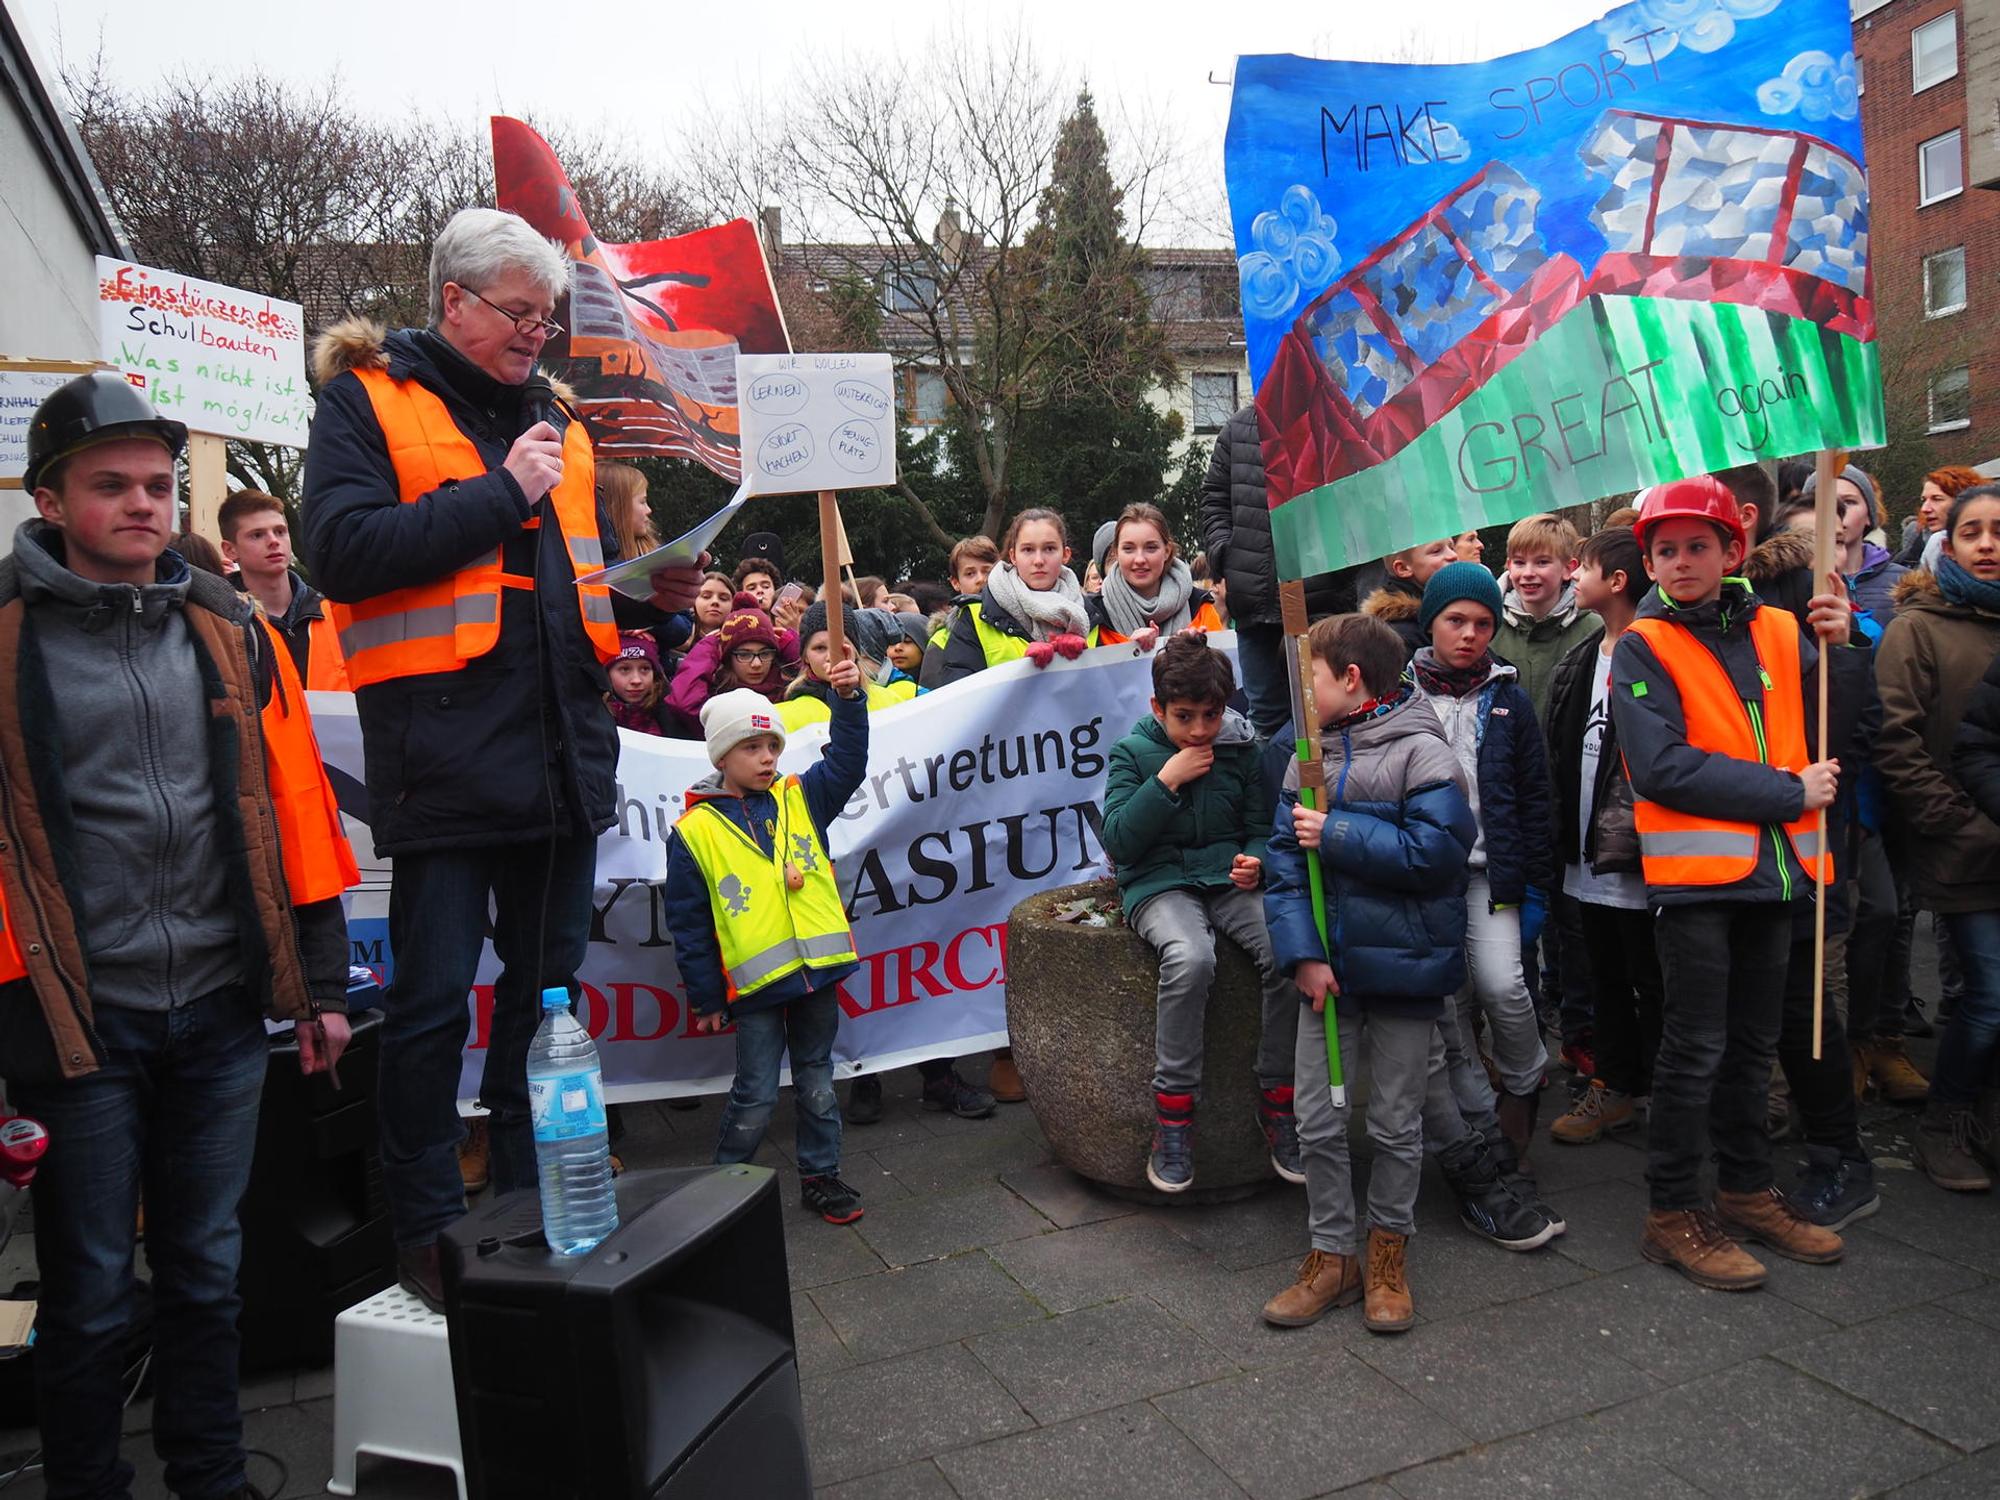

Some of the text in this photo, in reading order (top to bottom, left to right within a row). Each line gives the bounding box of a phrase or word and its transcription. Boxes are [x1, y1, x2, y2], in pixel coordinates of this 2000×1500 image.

[1320, 26, 1667, 178] MAKE SPORT
[116, 266, 285, 330] Einstürzende
[126, 306, 278, 361] Schulbauten
[778, 358, 857, 371] WIR WOLLEN
[151, 377, 187, 407] ist
[196, 363, 255, 388] nicht
[265, 375, 296, 396] ist
[752, 383, 802, 401] LERNEN
[767, 427, 802, 449] SPORT
[842, 425, 876, 448] GENUG
[1456, 359, 1808, 494] GREAT again
[765, 446, 809, 473] MACHEN
[838, 439, 867, 461] PLATZ
